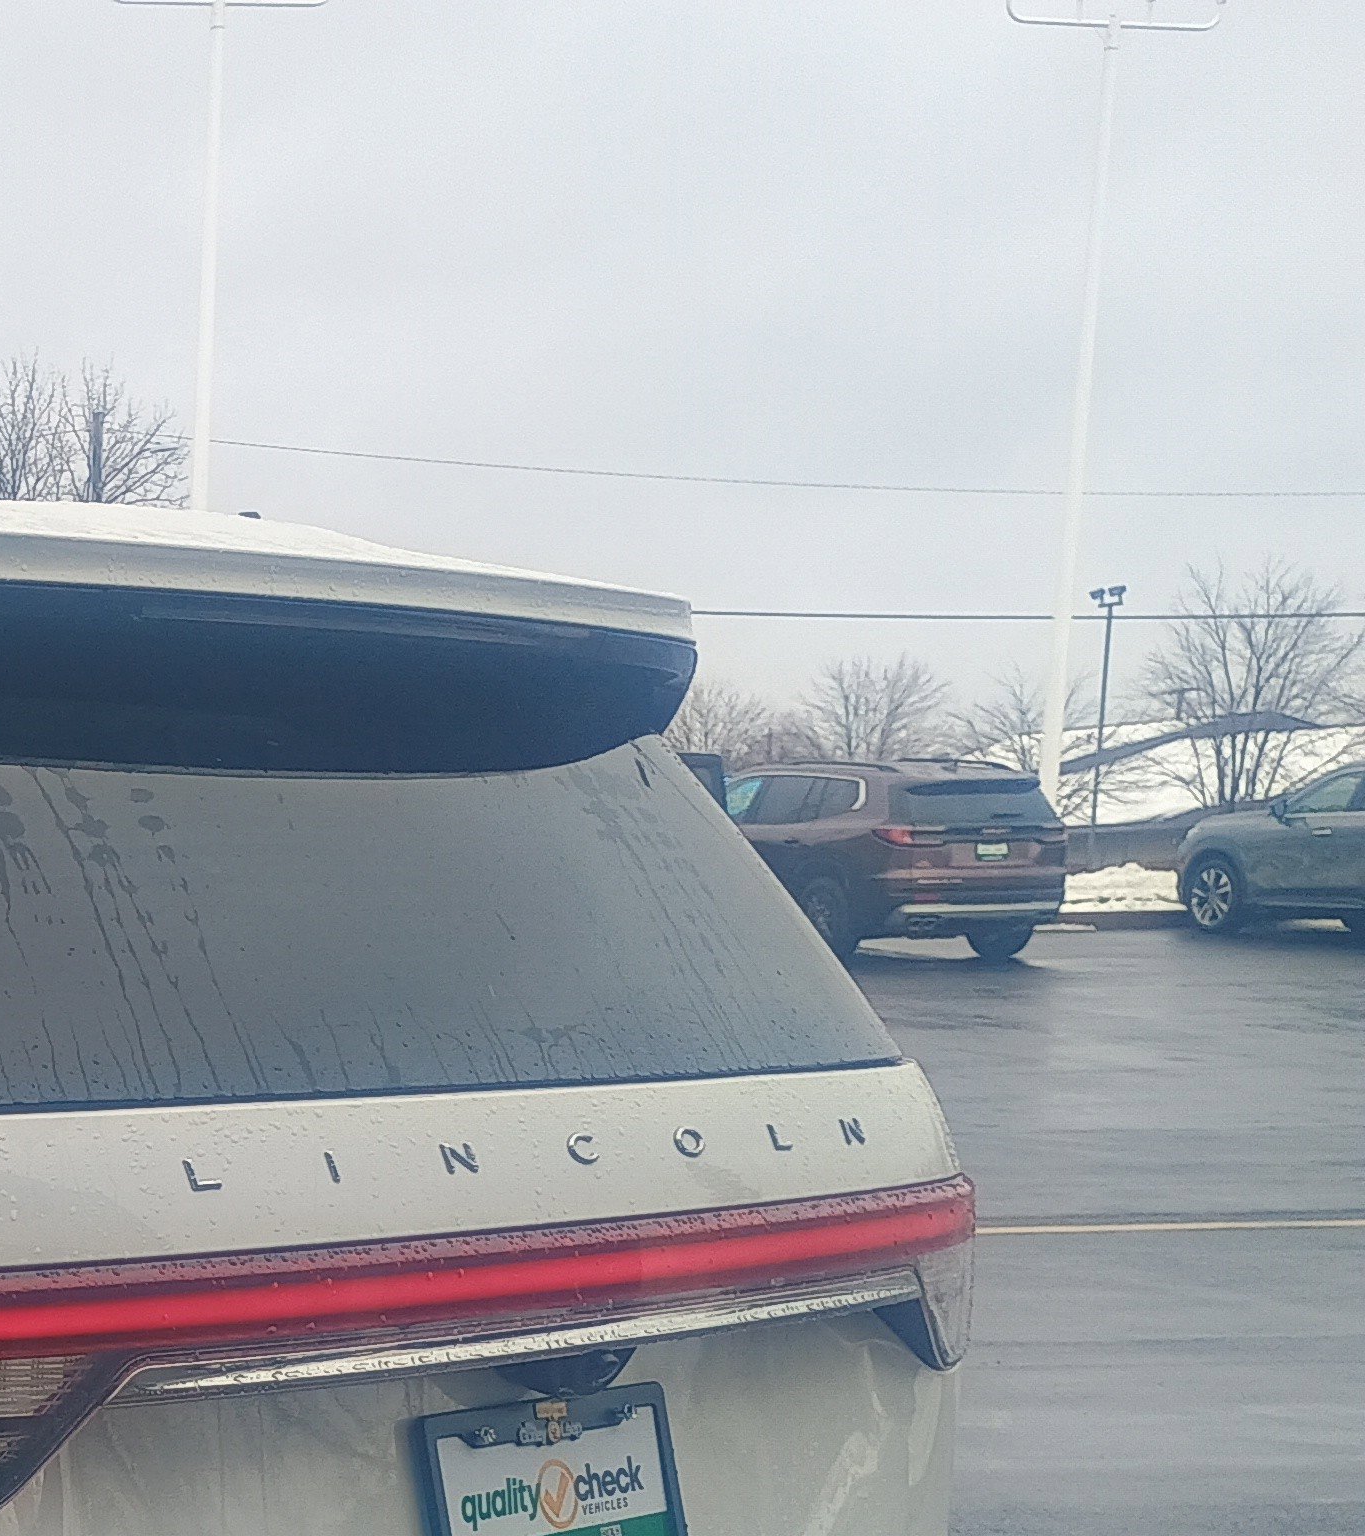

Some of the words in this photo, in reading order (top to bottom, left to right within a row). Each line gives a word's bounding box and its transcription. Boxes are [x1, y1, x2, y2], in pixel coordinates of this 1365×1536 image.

[182, 1116, 867, 1192] LINCOLN
[461, 1477, 540, 1531] quality
[574, 1455, 644, 1502] check
[581, 1497, 629, 1516] VEHICLES
